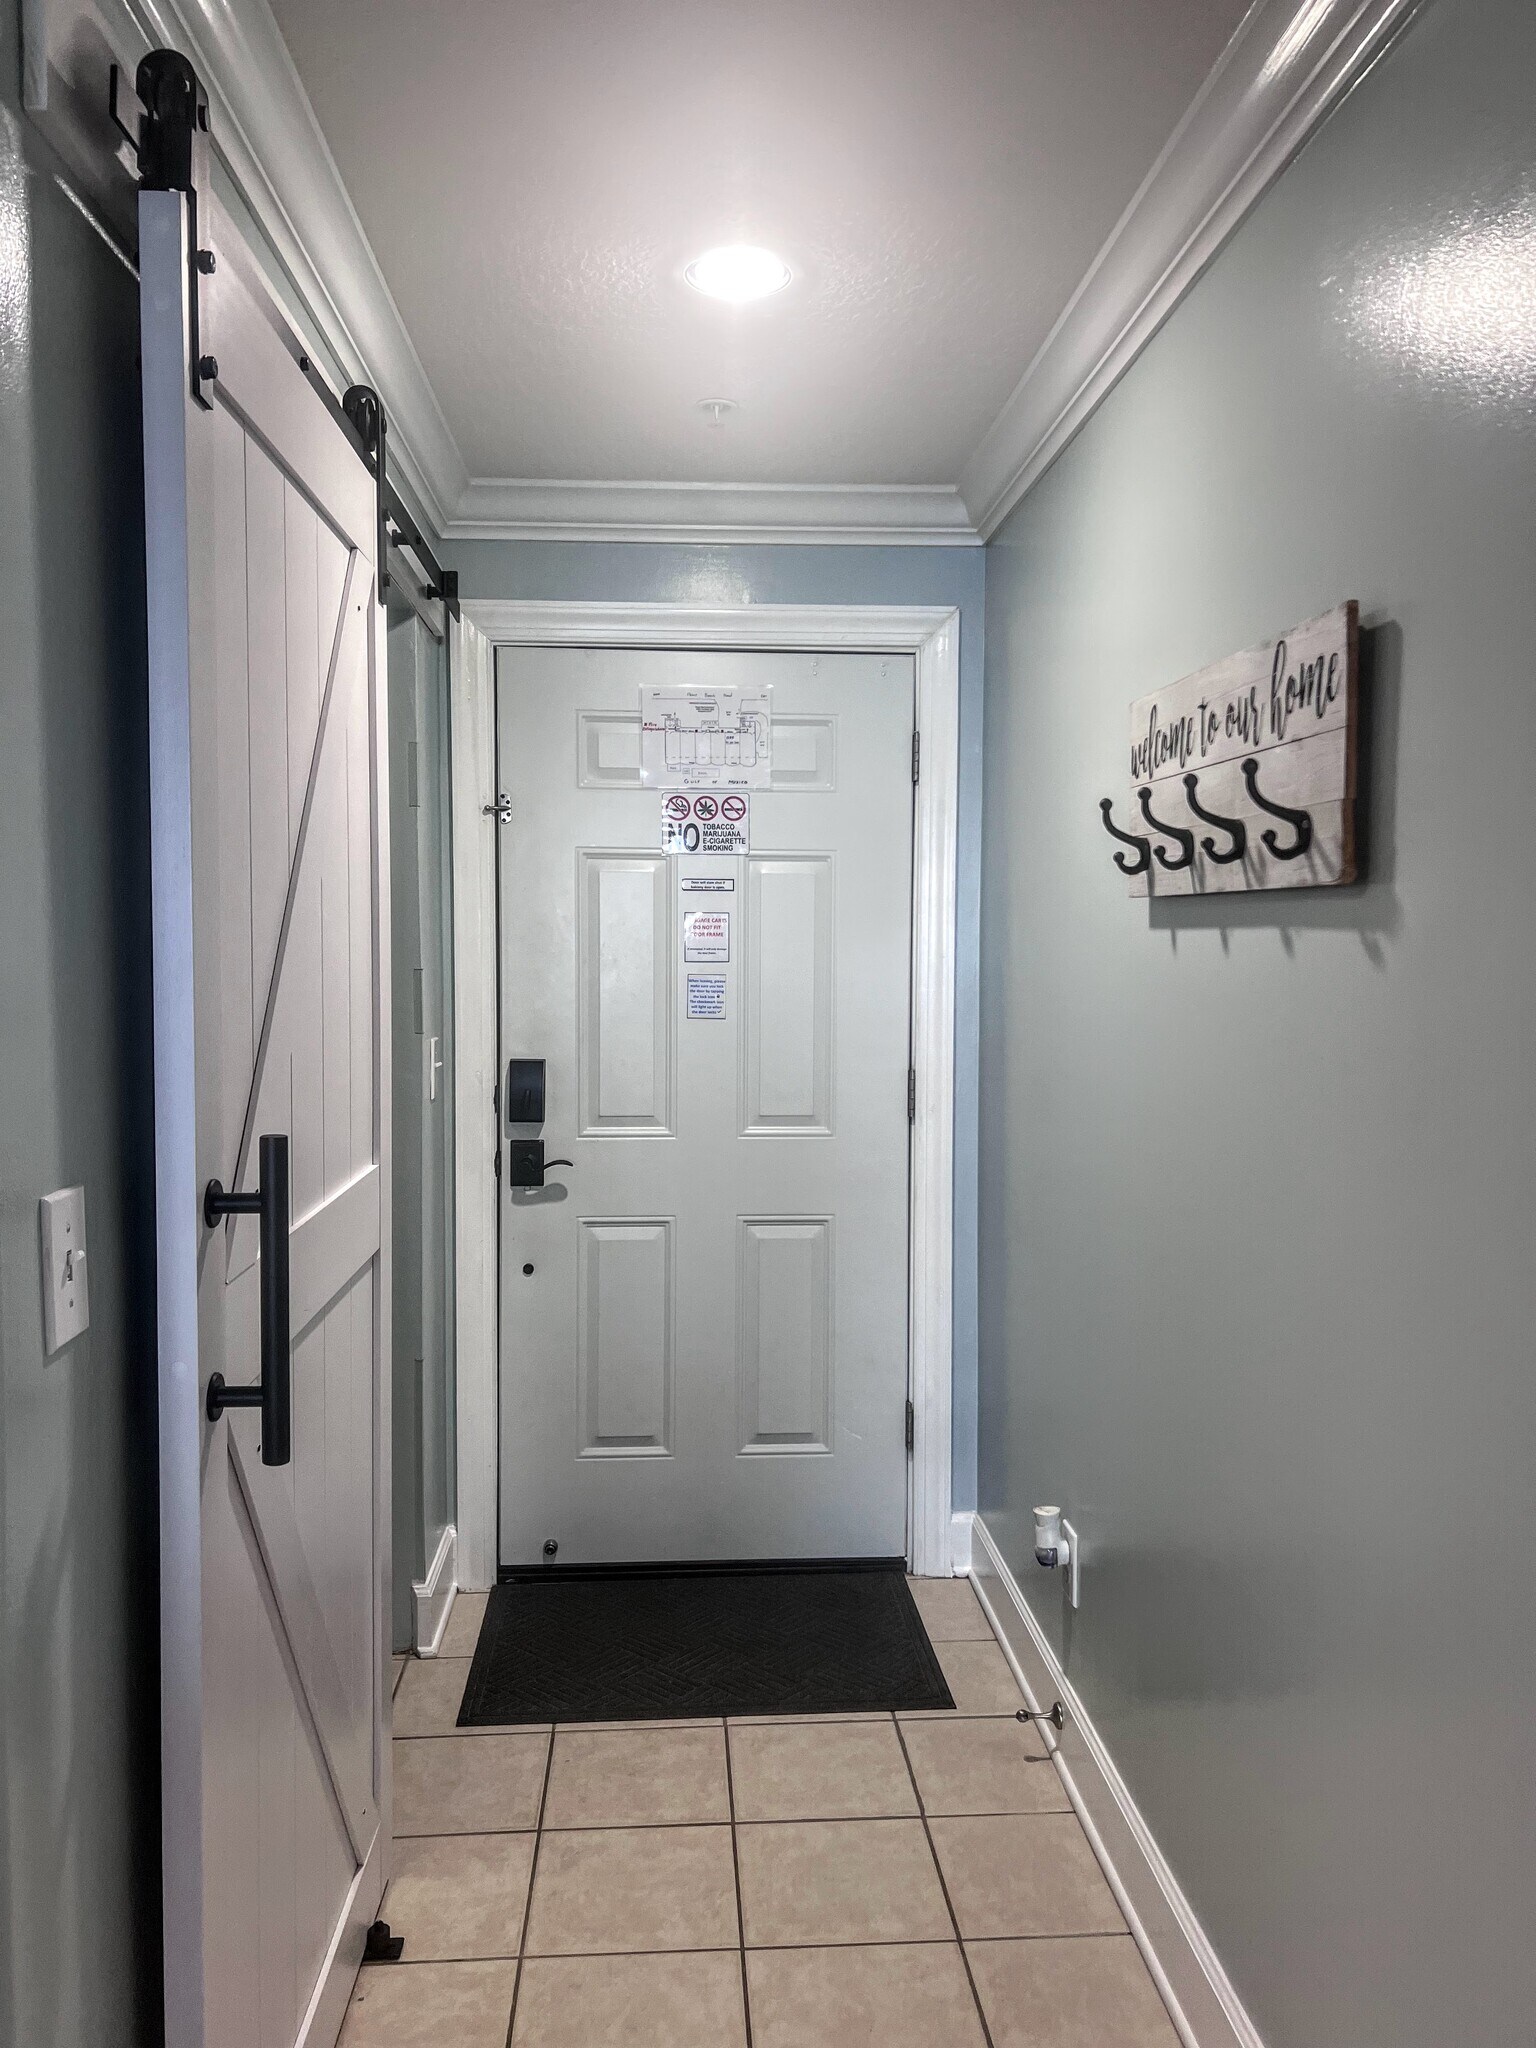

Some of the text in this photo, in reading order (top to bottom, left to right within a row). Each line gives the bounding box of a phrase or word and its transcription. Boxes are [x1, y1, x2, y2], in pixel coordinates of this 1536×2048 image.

[1130, 639, 1340, 780] welcome to our home
[668, 822, 700, 852] NO
[702, 844, 734, 852] SMOKING
